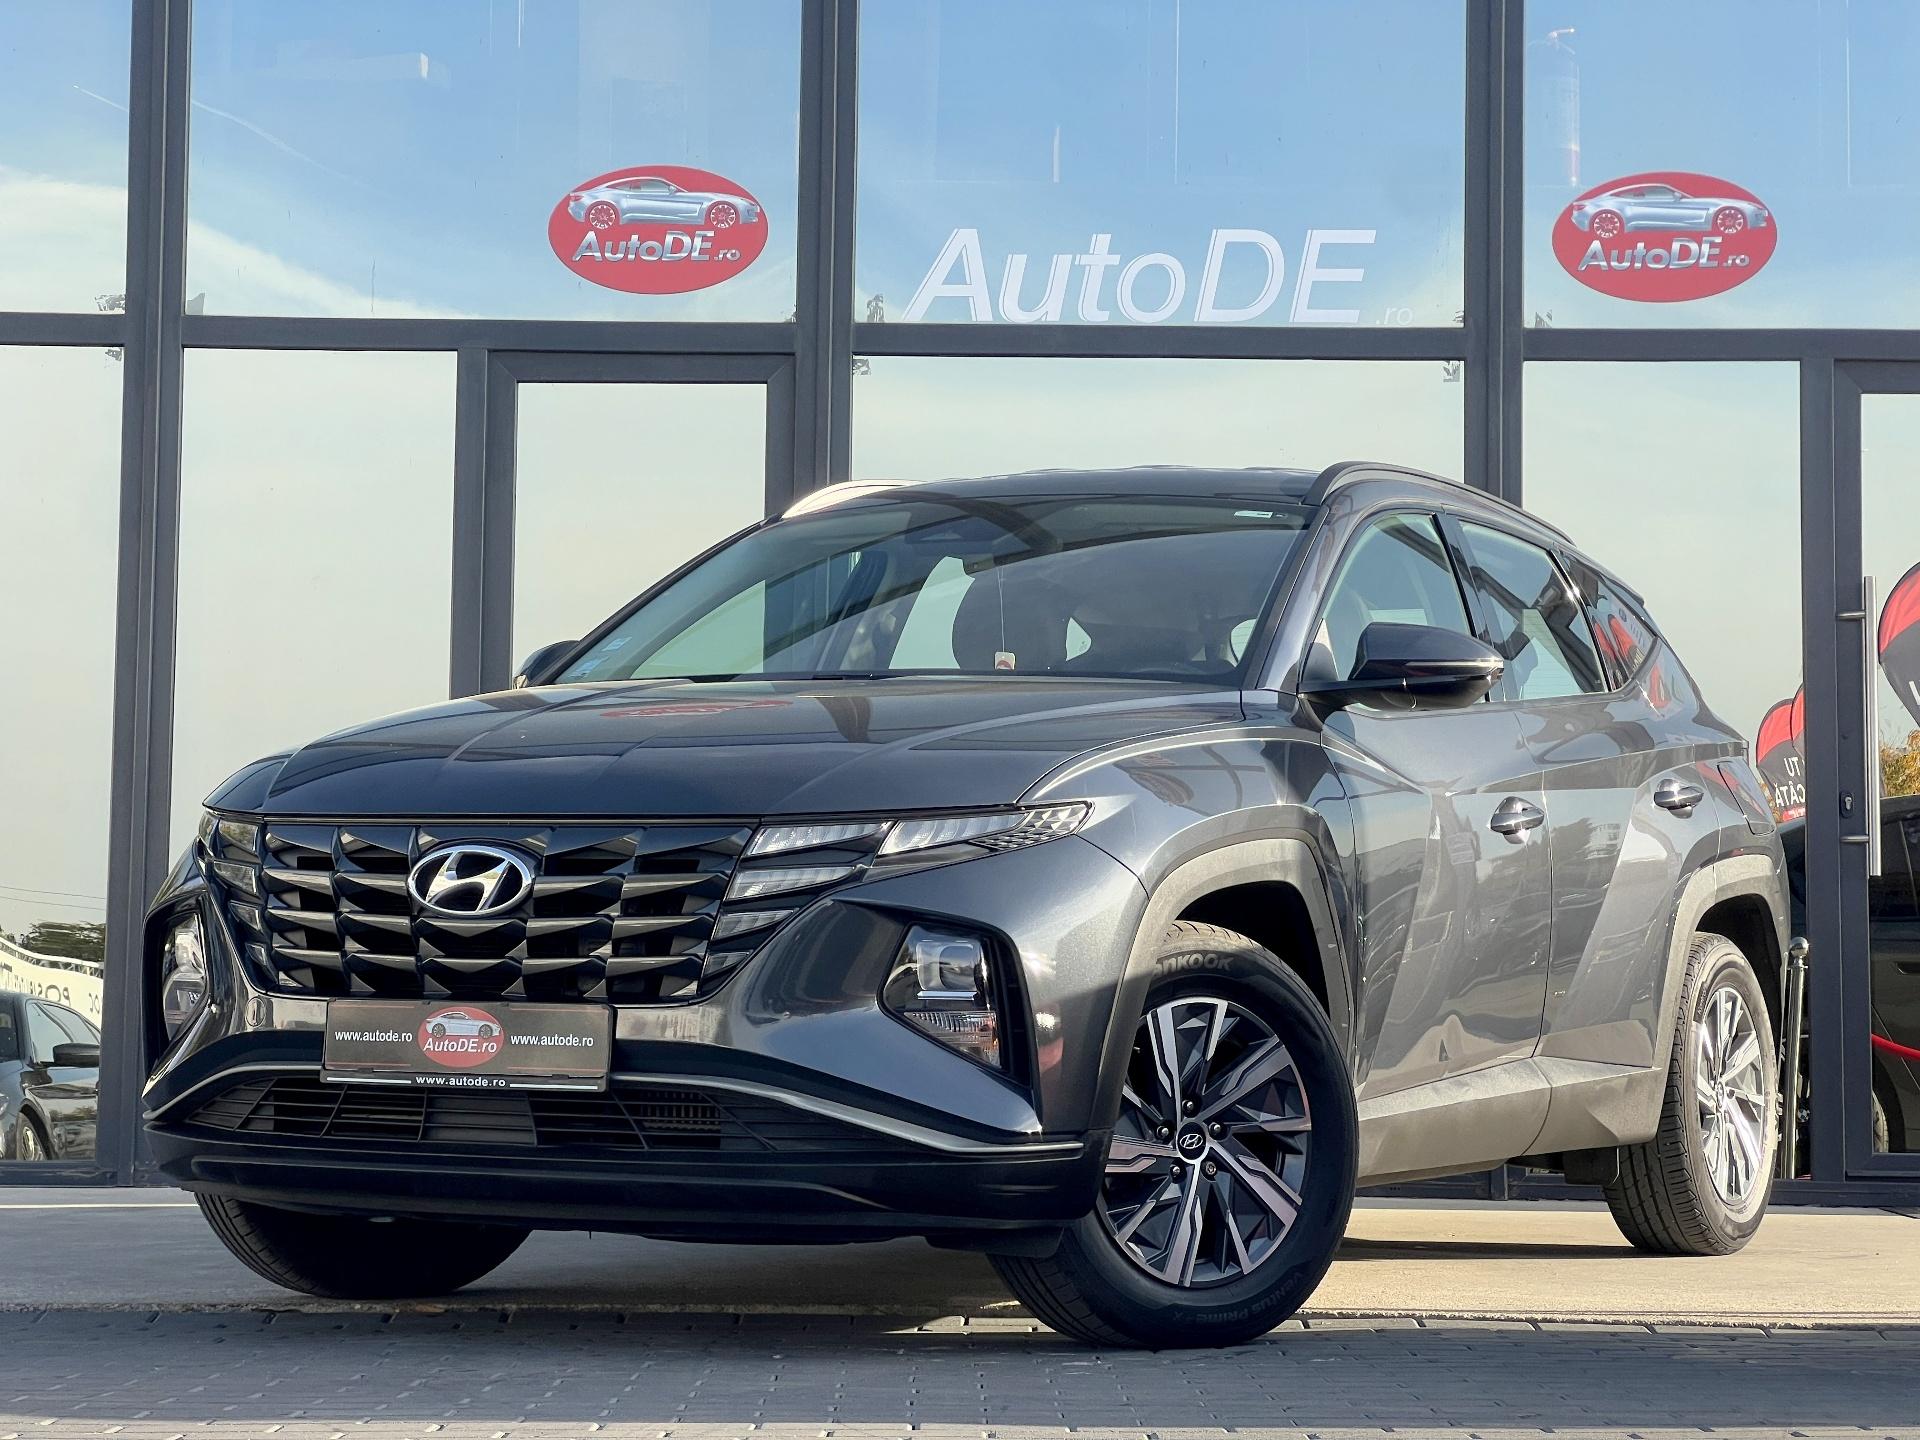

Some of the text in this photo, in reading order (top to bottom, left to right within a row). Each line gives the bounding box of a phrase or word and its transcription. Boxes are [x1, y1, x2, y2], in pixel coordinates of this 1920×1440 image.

[334, 1029, 413, 1043] www.autode.ro
[510, 1033, 594, 1048] www.autode.ro
[423, 1037, 498, 1053] AutoDE.ro
[415, 1075, 506, 1088] www.autode.ro
